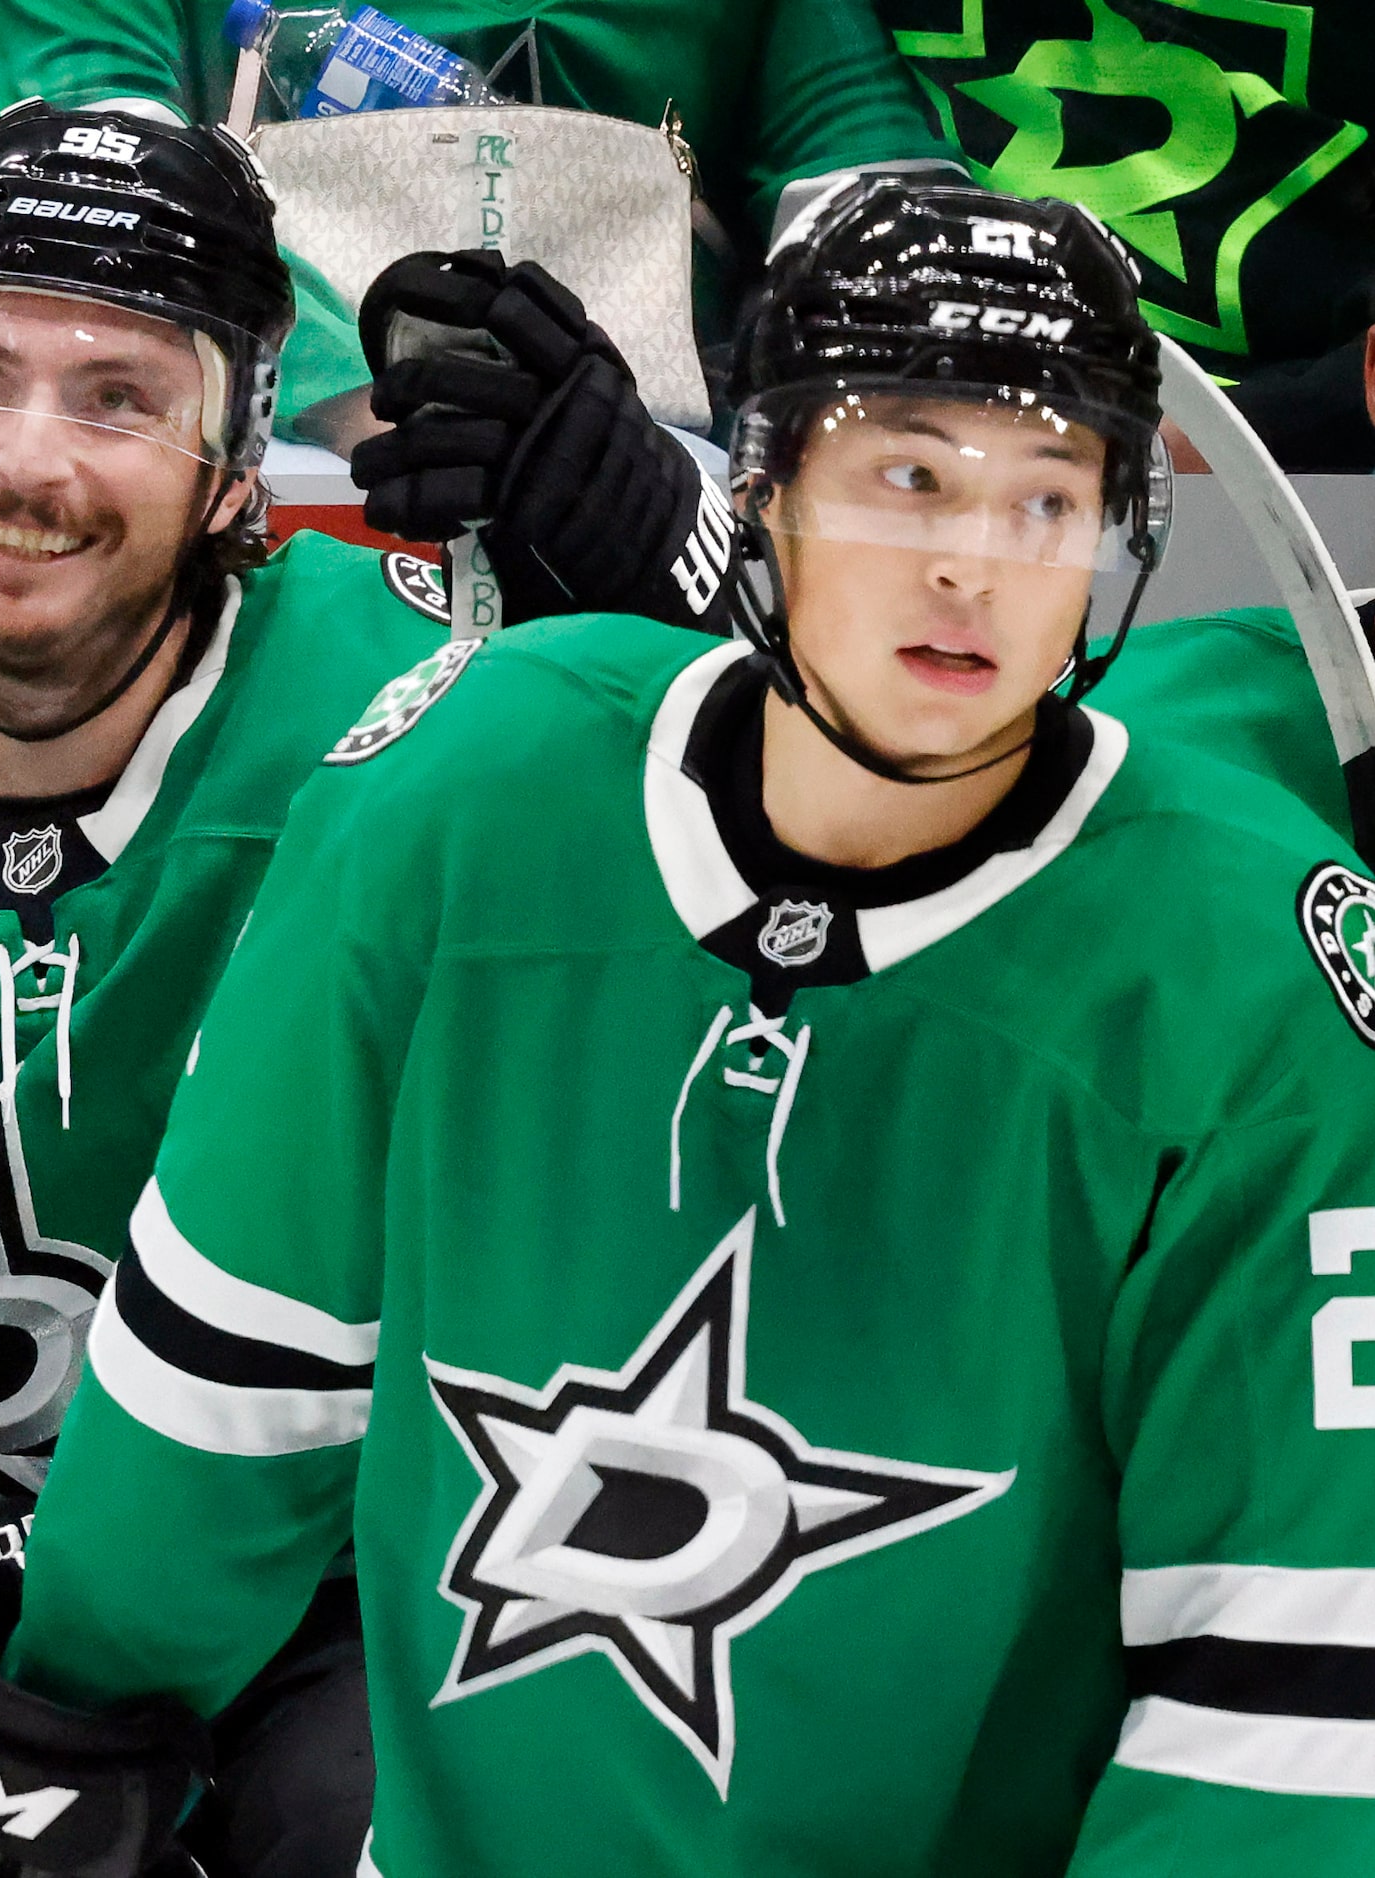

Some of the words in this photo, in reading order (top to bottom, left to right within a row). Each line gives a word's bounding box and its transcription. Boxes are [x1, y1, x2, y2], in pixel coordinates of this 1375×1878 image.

[58, 127, 142, 163] 95
[7, 197, 141, 230] BAUER
[929, 300, 1074, 342] CCM
[670, 465, 736, 616] IOR
[18, 842, 52, 882] NHL
